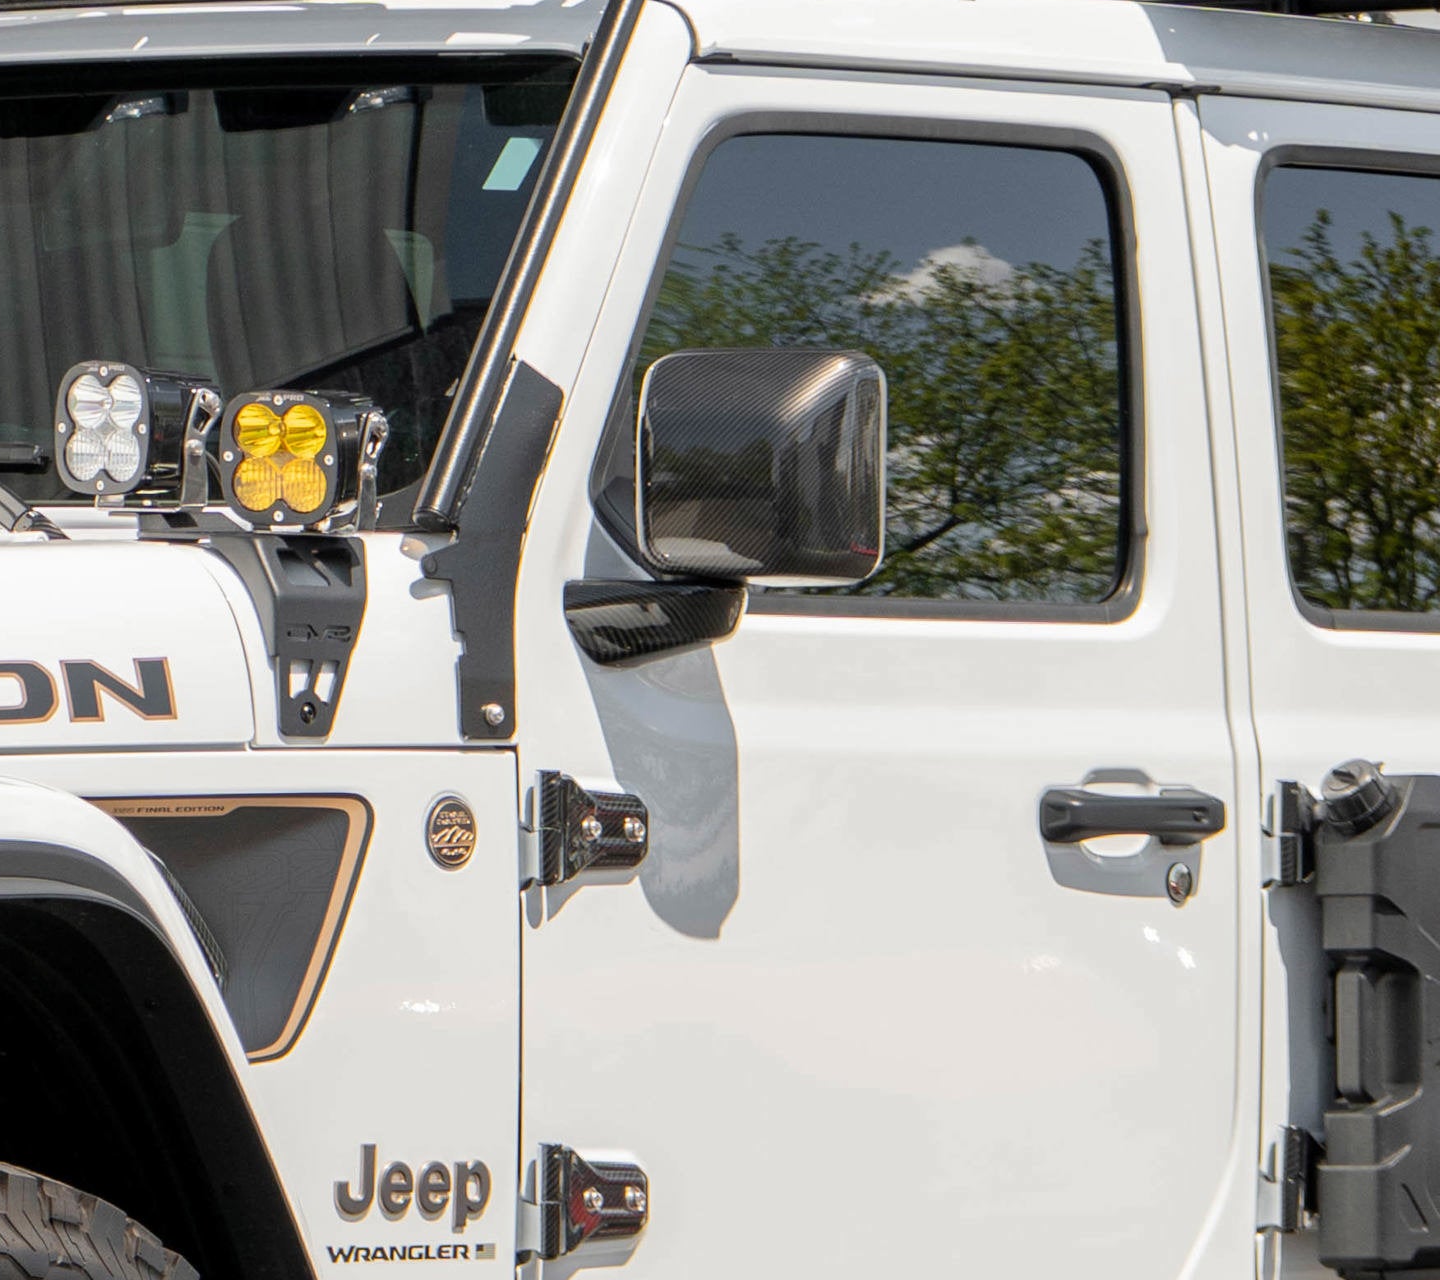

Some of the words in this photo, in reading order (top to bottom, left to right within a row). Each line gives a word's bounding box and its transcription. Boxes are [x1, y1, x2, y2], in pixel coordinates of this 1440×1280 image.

[137, 806, 173, 814] FINAL
[174, 805, 225, 813] EDITION
[333, 1143, 492, 1234] Jeep
[326, 1244, 470, 1264] WRANGLER
